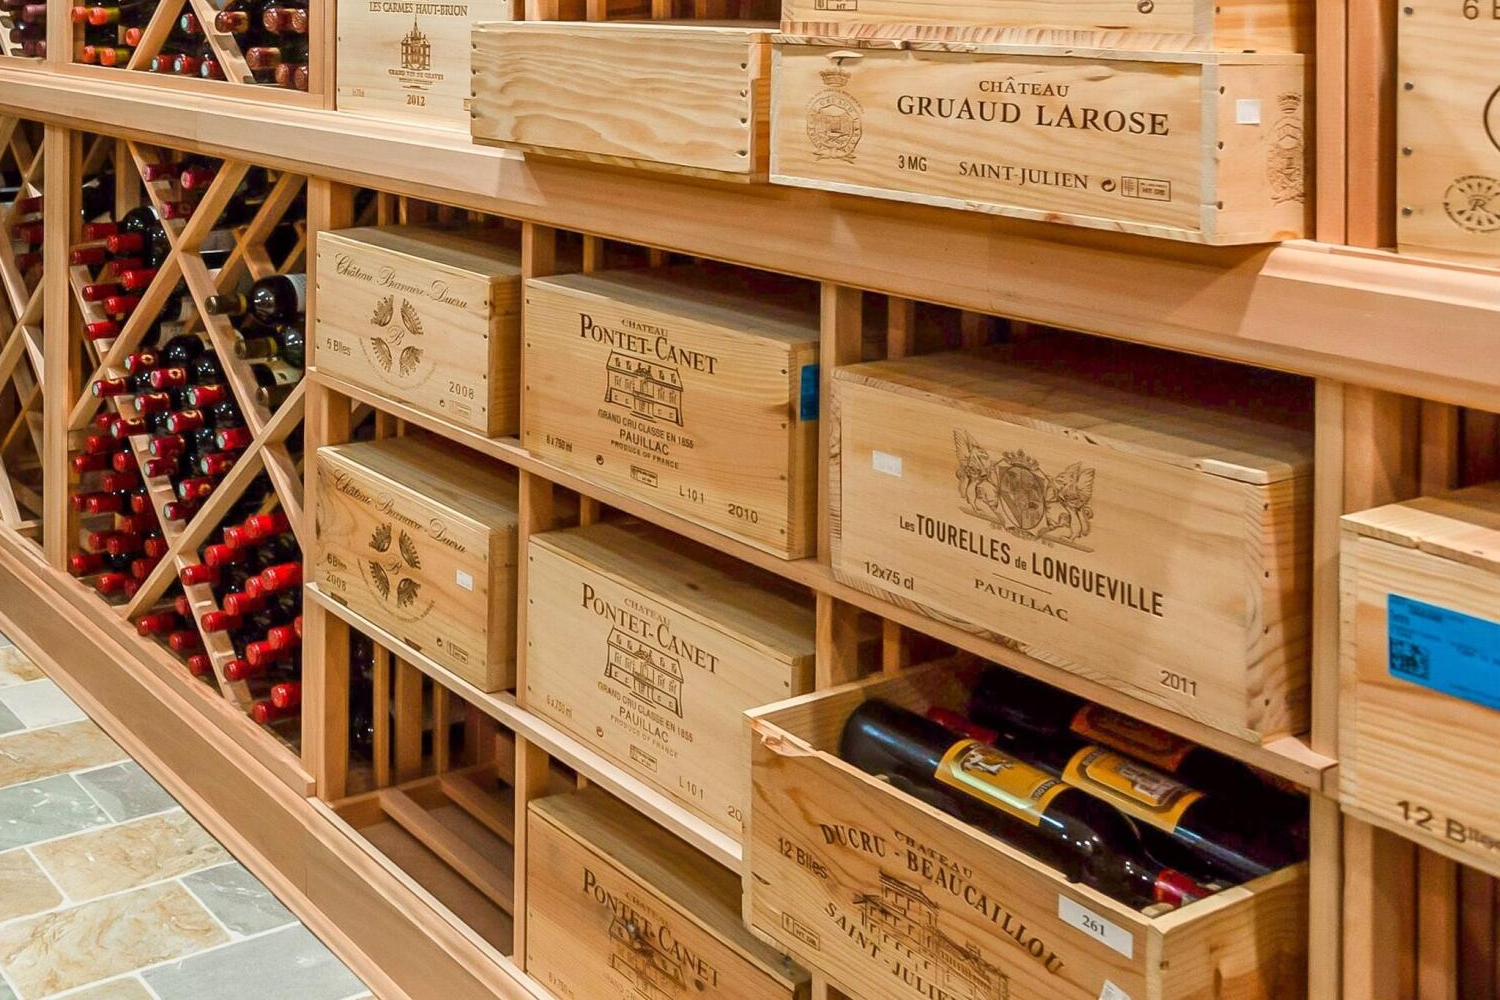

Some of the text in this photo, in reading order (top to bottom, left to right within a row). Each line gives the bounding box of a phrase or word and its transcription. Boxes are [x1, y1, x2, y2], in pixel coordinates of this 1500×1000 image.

[369, 1, 468, 17] LES CARMES HAUT-BRION
[407, 94, 426, 107] 2012
[978, 76, 1070, 98] CHÂTEAU
[897, 94, 1170, 138] GRUAUD LAROSE
[898, 155, 927, 173] 3 MG
[959, 161, 1089, 190] SAINT-JULIEN
[449, 381, 475, 400] 2008
[598, 408, 621, 425] GRAND
[622, 417, 636, 430] CRU
[666, 432, 676, 443] EN
[678, 436, 694, 449] 1855
[619, 429, 669, 456] PAUILLAC
[652, 455, 679, 470] FRANCE
[728, 503, 758, 524] 2010
[864, 560, 914, 591] 12x75 cl
[900, 513, 1164, 618] Les TOURELLES de LONGUEVILLE
[326, 571, 347, 592] 2008
[974, 577, 1069, 622] PAUILLAC
[1160, 669, 1198, 697] 2011
[598, 681, 621, 701] GRAND
[622, 695, 637, 710] CRU
[665, 720, 676, 733] EN
[677, 727, 693, 743] 1855
[619, 705, 669, 743] PAUILLAC
[728, 805, 743, 822] 20
[1396, 800, 1435, 832] 12
[778, 837, 792, 859] 12
[820, 823, 887, 858] DUCRU
[906, 850, 1066, 974] BEAUCAILLOU
[1081, 914, 1106, 937] 261
[824, 902, 956, 1000] SAINT-JULIE
